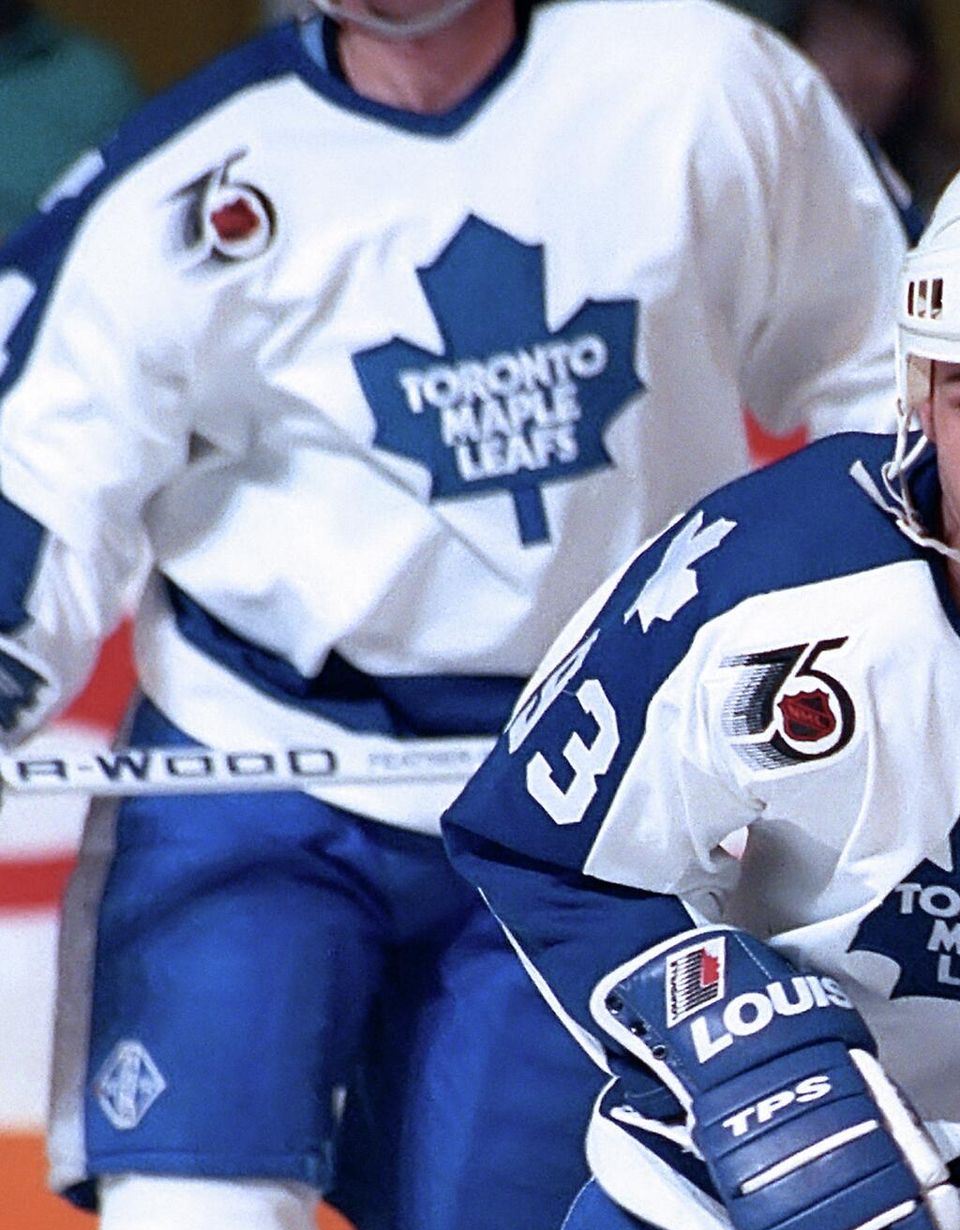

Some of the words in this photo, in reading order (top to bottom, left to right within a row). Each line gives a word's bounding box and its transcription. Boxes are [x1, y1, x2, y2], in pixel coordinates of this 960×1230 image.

[400, 335, 607, 413] TORONTO
[441, 384, 580, 446] MAPLE
[455, 426, 578, 481] LEAFS
[719, 636, 856, 771] 75
[722, 1075, 832, 1137] TPS
